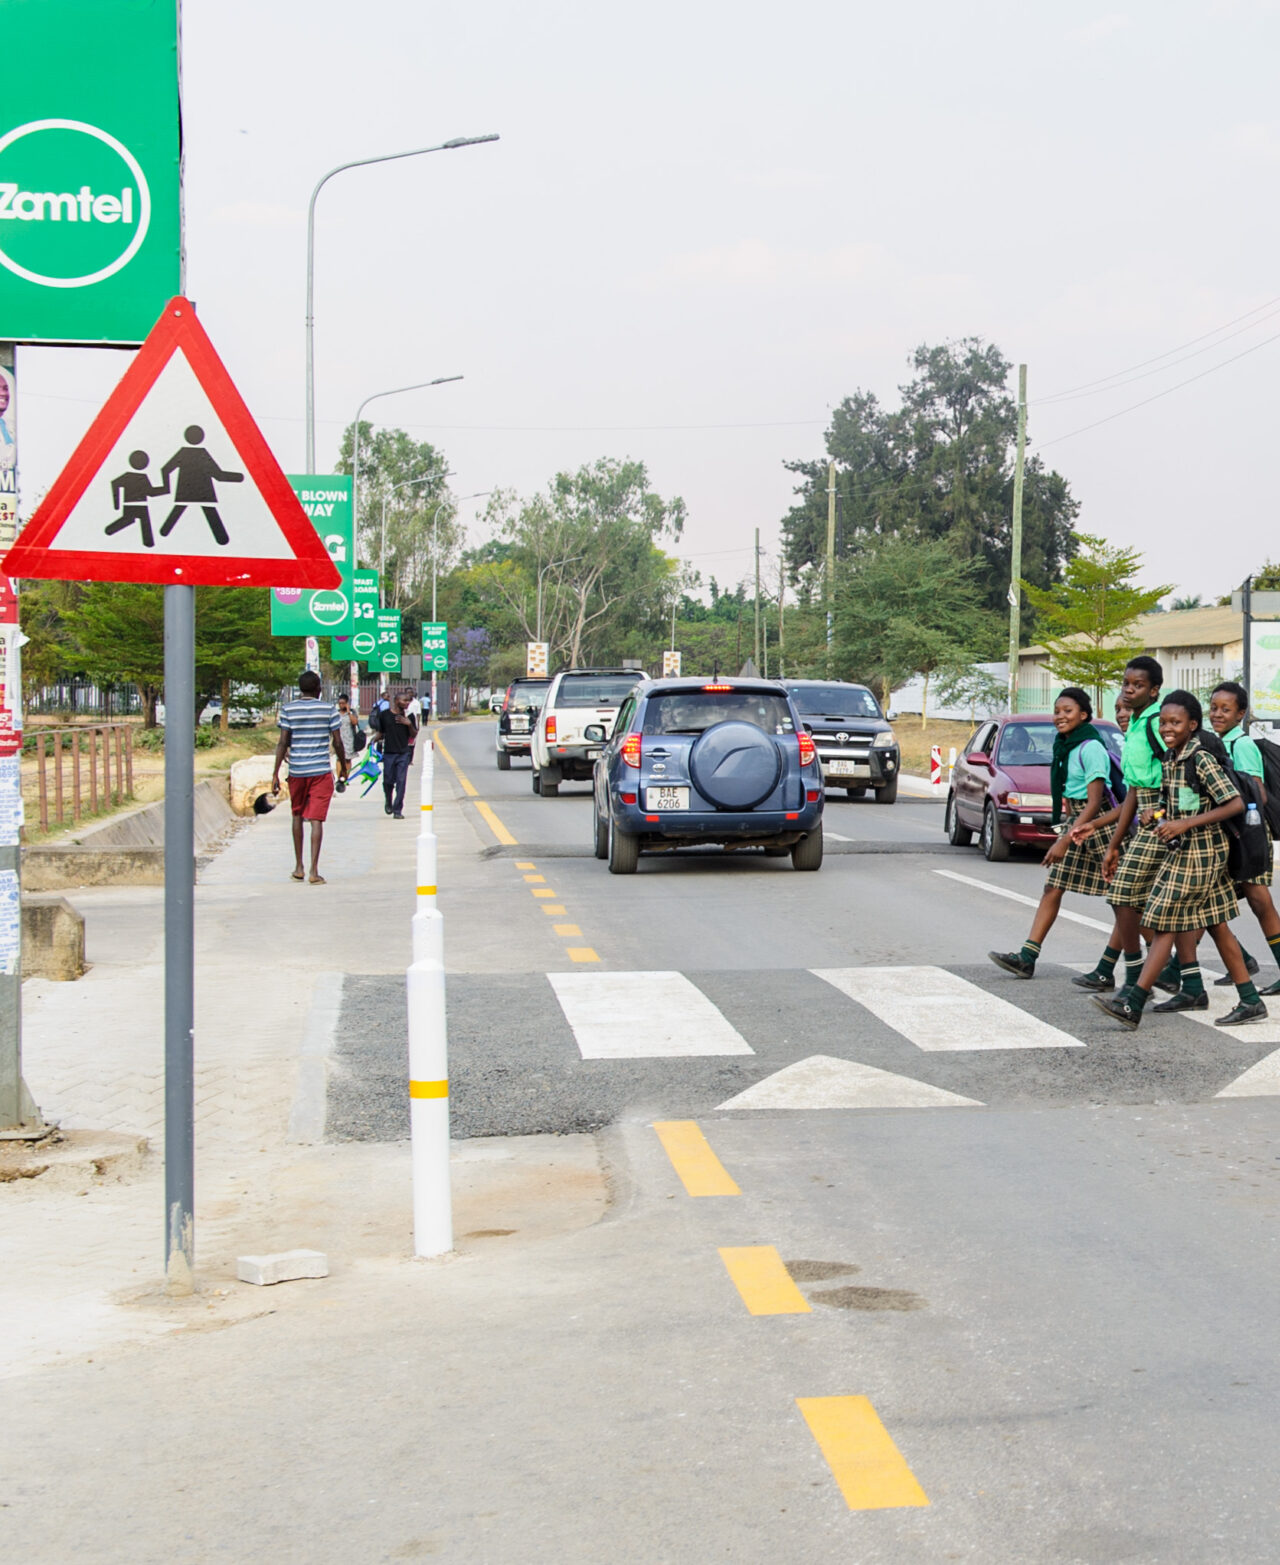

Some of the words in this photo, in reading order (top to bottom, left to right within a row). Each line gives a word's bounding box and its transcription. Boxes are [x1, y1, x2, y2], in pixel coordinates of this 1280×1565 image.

[0, 183, 133, 223] Zamtel
[301, 491, 347, 502] BLOWN
[301, 503, 334, 517] WAY
[313, 602, 345, 611] Zamtel
[660, 787, 678, 798] BAE
[657, 799, 680, 809] 6206
